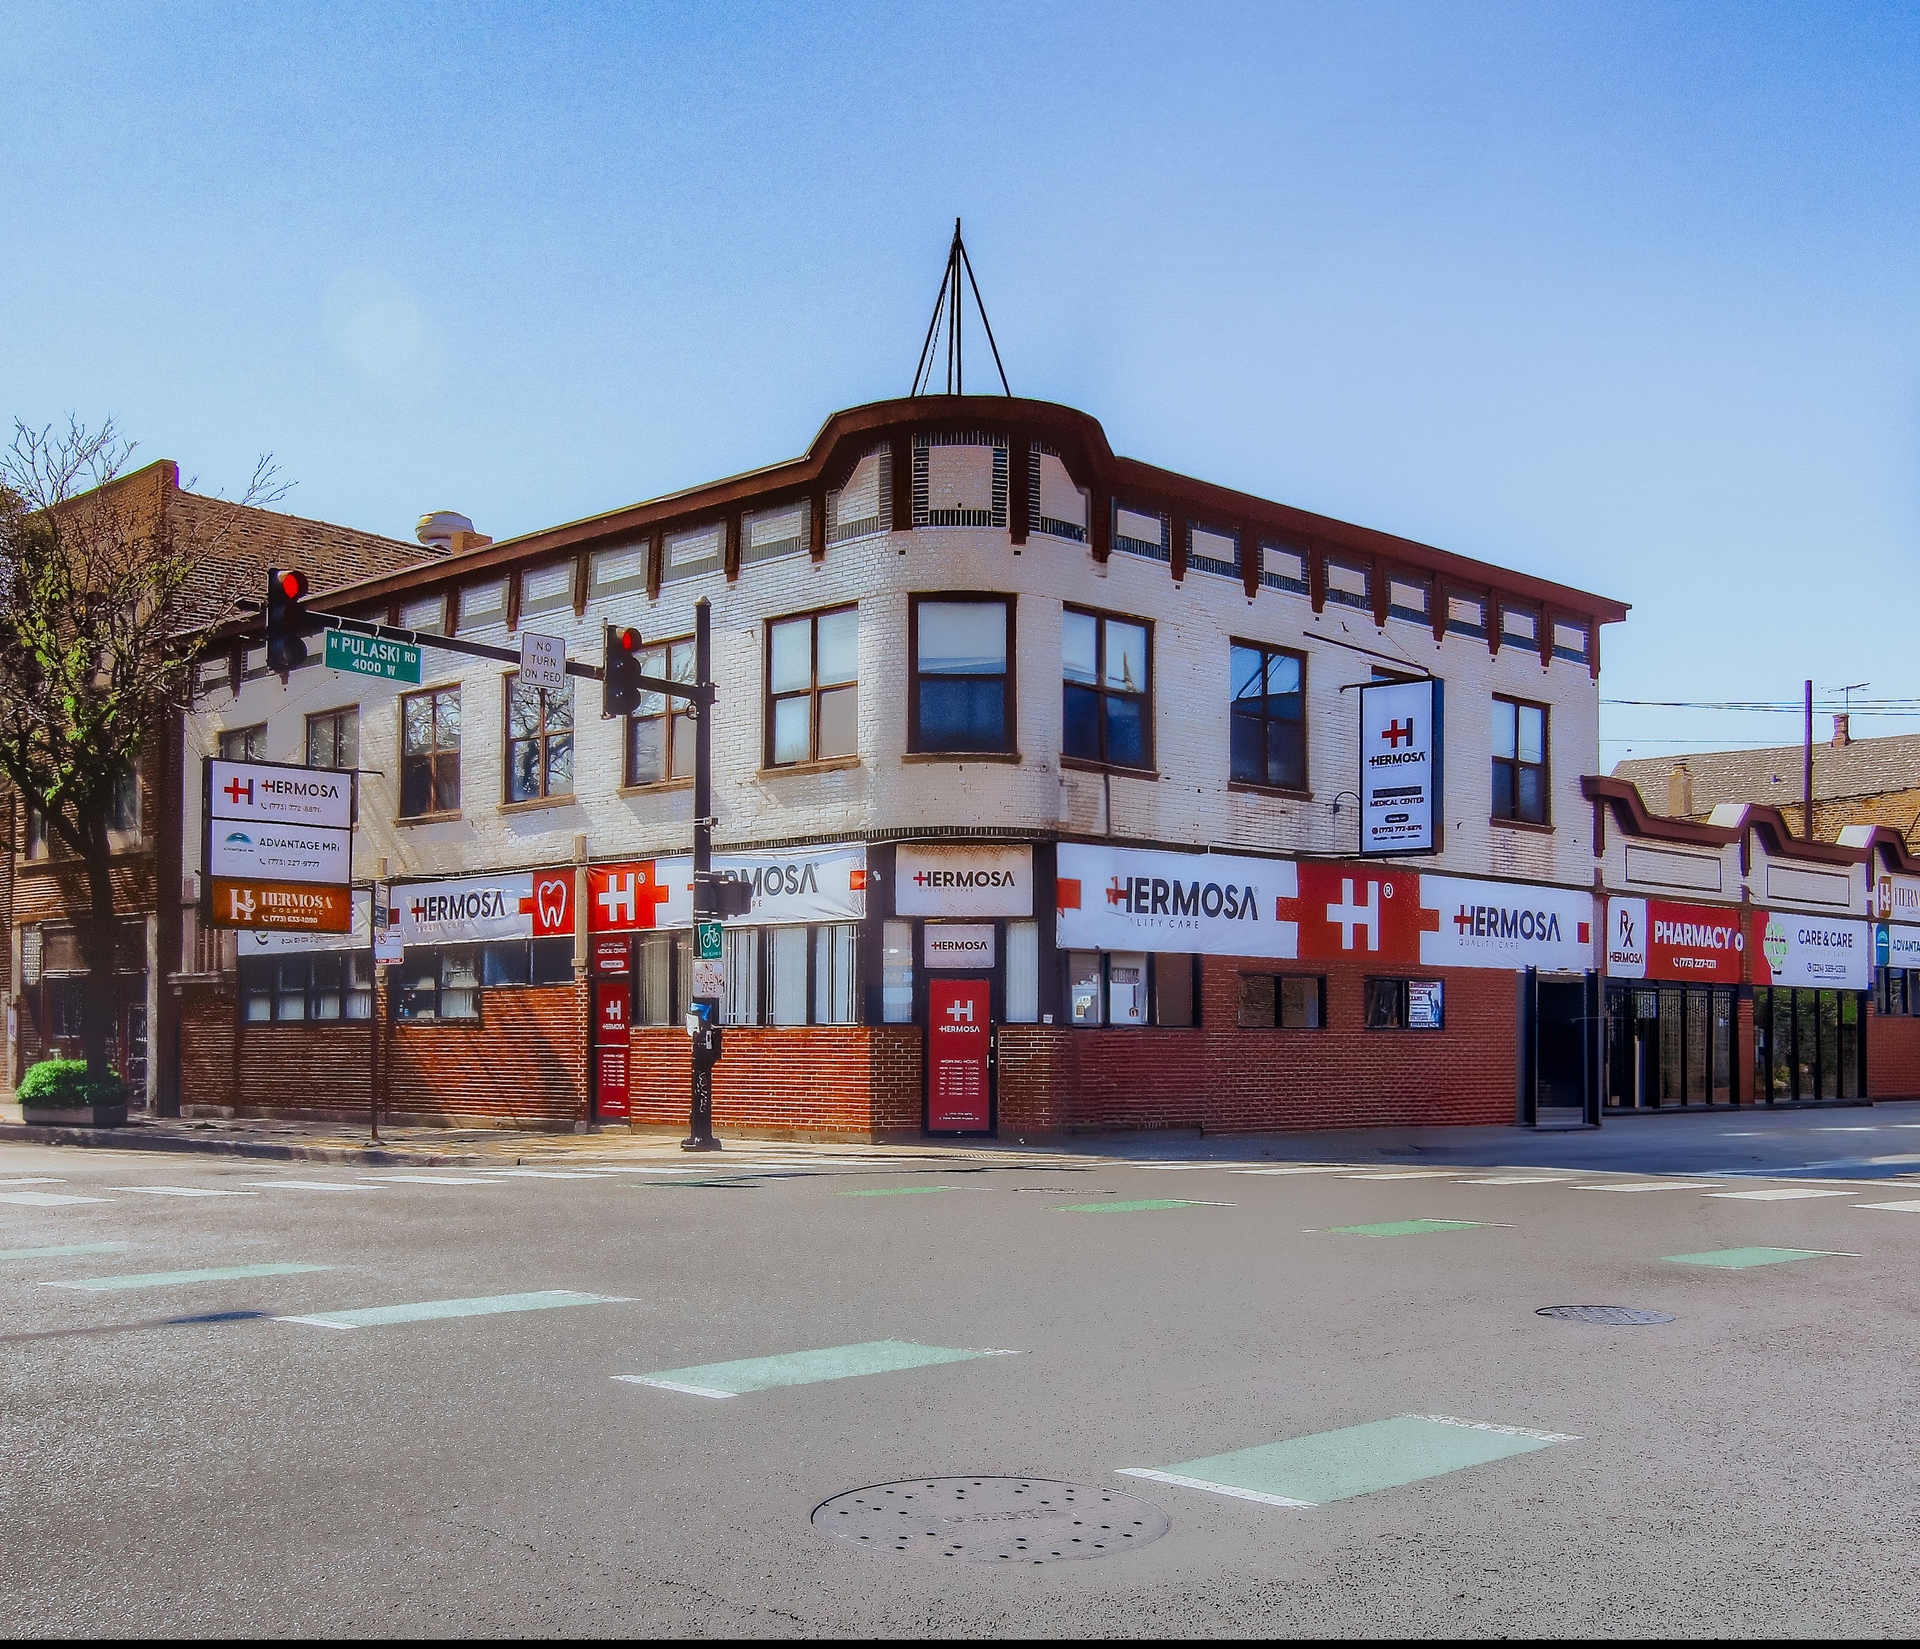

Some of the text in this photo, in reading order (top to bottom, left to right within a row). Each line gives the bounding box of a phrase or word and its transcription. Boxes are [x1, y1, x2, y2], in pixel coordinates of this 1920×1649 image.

[331, 636, 417, 664] N PULASKI RD
[536, 641, 552, 652] NO
[352, 661, 396, 676] 4000 W
[531, 655, 557, 668] TURN
[524, 667, 561, 683] ON RED
[1369, 751, 1426, 768] HERMOSA
[261, 779, 339, 799] HERMOSA
[1370, 797, 1424, 807] MEDICAL CENTER
[259, 838, 320, 851] ADVANTAGE
[913, 870, 1015, 888] HERMOSA
[261, 891, 333, 909] HERMOSA
[1106, 876, 1259, 921] HERMOSA
[272, 907, 324, 915] COSMETIC
[411, 891, 506, 923] HERMOSA
[1169, 919, 1199, 930] CARE
[1453, 904, 1561, 942] HERMOSA
[1654, 920, 1732, 949] PHARMACY
[931, 941, 988, 951] HERMOSA
[1458, 938, 1519, 950] QUALITY CARE
[1609, 952, 1643, 964] HERMOSA
[938, 1025, 980, 1033] HERMOSA
